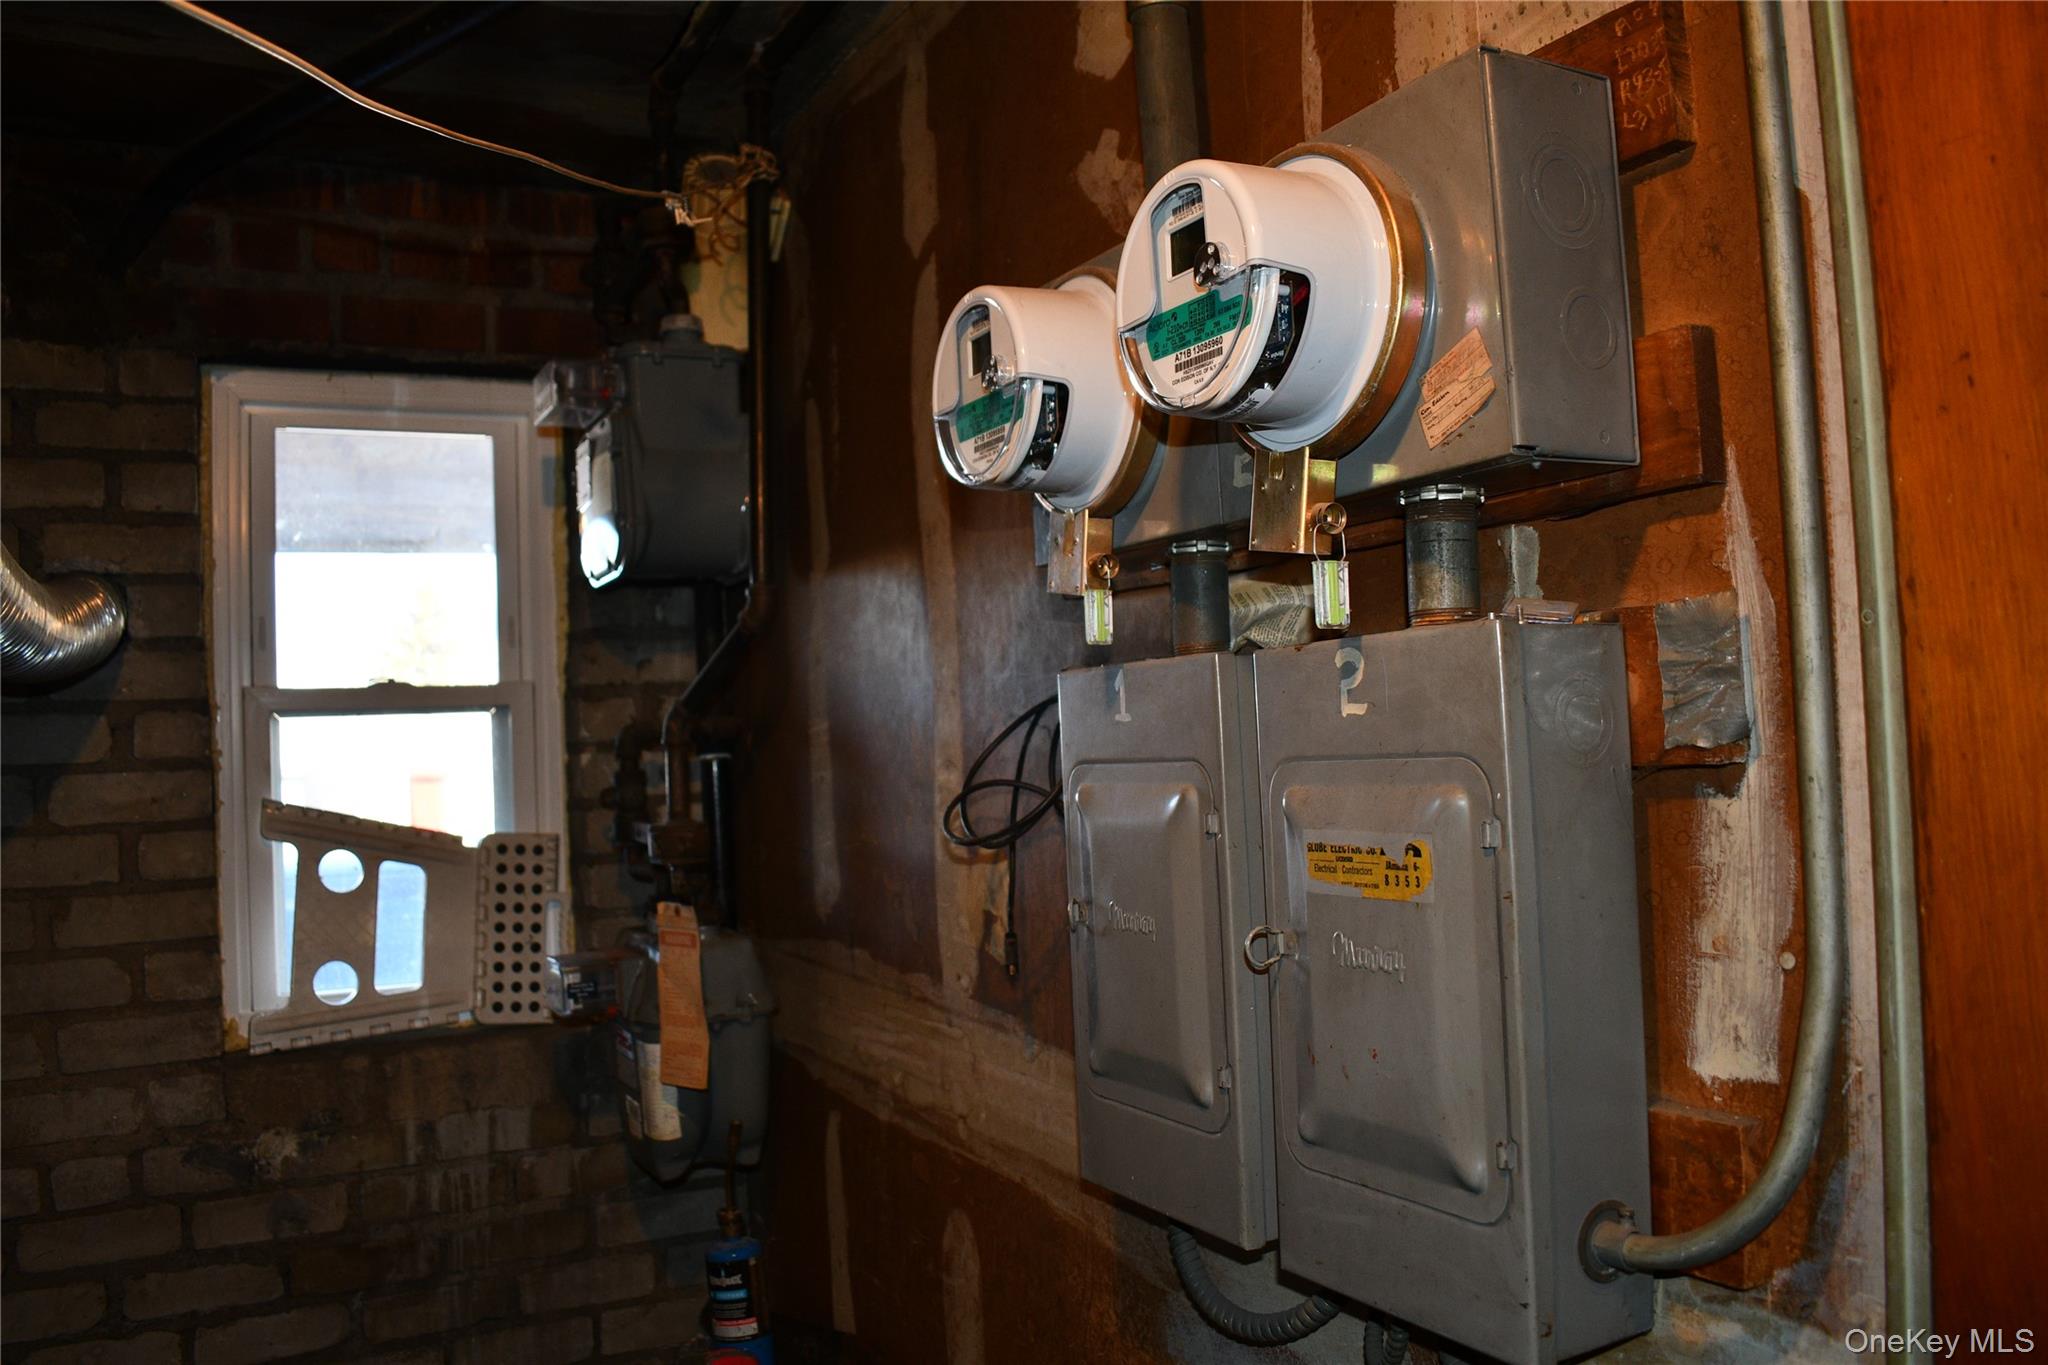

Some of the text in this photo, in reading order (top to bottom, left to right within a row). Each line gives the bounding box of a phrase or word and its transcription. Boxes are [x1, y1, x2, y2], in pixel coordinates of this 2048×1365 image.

[1174, 348, 1192, 363] A71B
[1193, 335, 1224, 355] 13095960
[1114, 668, 1132, 722] 1
[1335, 647, 1368, 718] 2
[1306, 842, 1327, 854] GLOBE
[1314, 863, 1374, 877] Electrical Contractors
[1108, 900, 1157, 943] Murray
[1332, 930, 1406, 984] Murray
